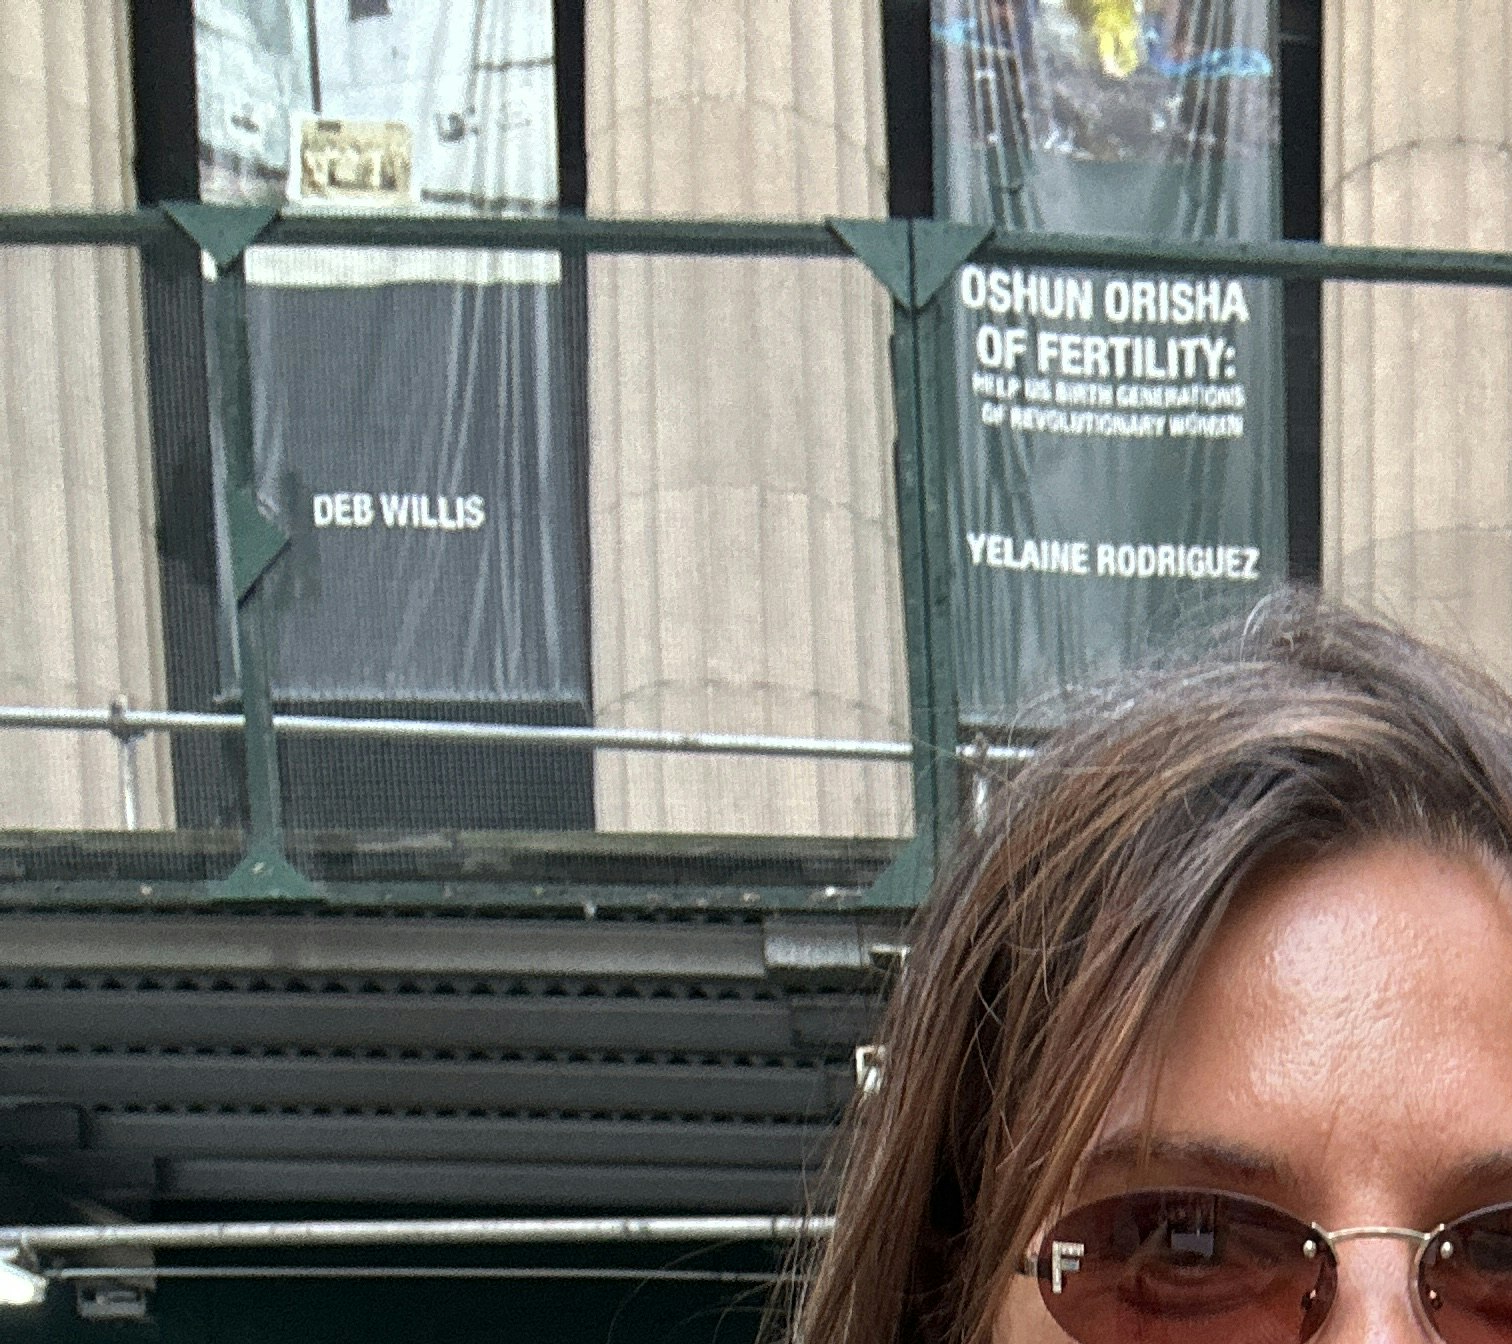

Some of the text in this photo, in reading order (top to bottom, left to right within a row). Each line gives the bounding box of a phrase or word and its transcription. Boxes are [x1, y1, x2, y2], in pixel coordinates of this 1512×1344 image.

[960, 264, 1250, 325] OSHUN ORISHA
[976, 324, 1237, 380] OF FERTILITY:
[1009, 405, 1166, 438] REVOLUTIONARY
[313, 492, 486, 530] DEB WILLIS
[966, 533, 1261, 581] YELAINE RODRIGUEZ
